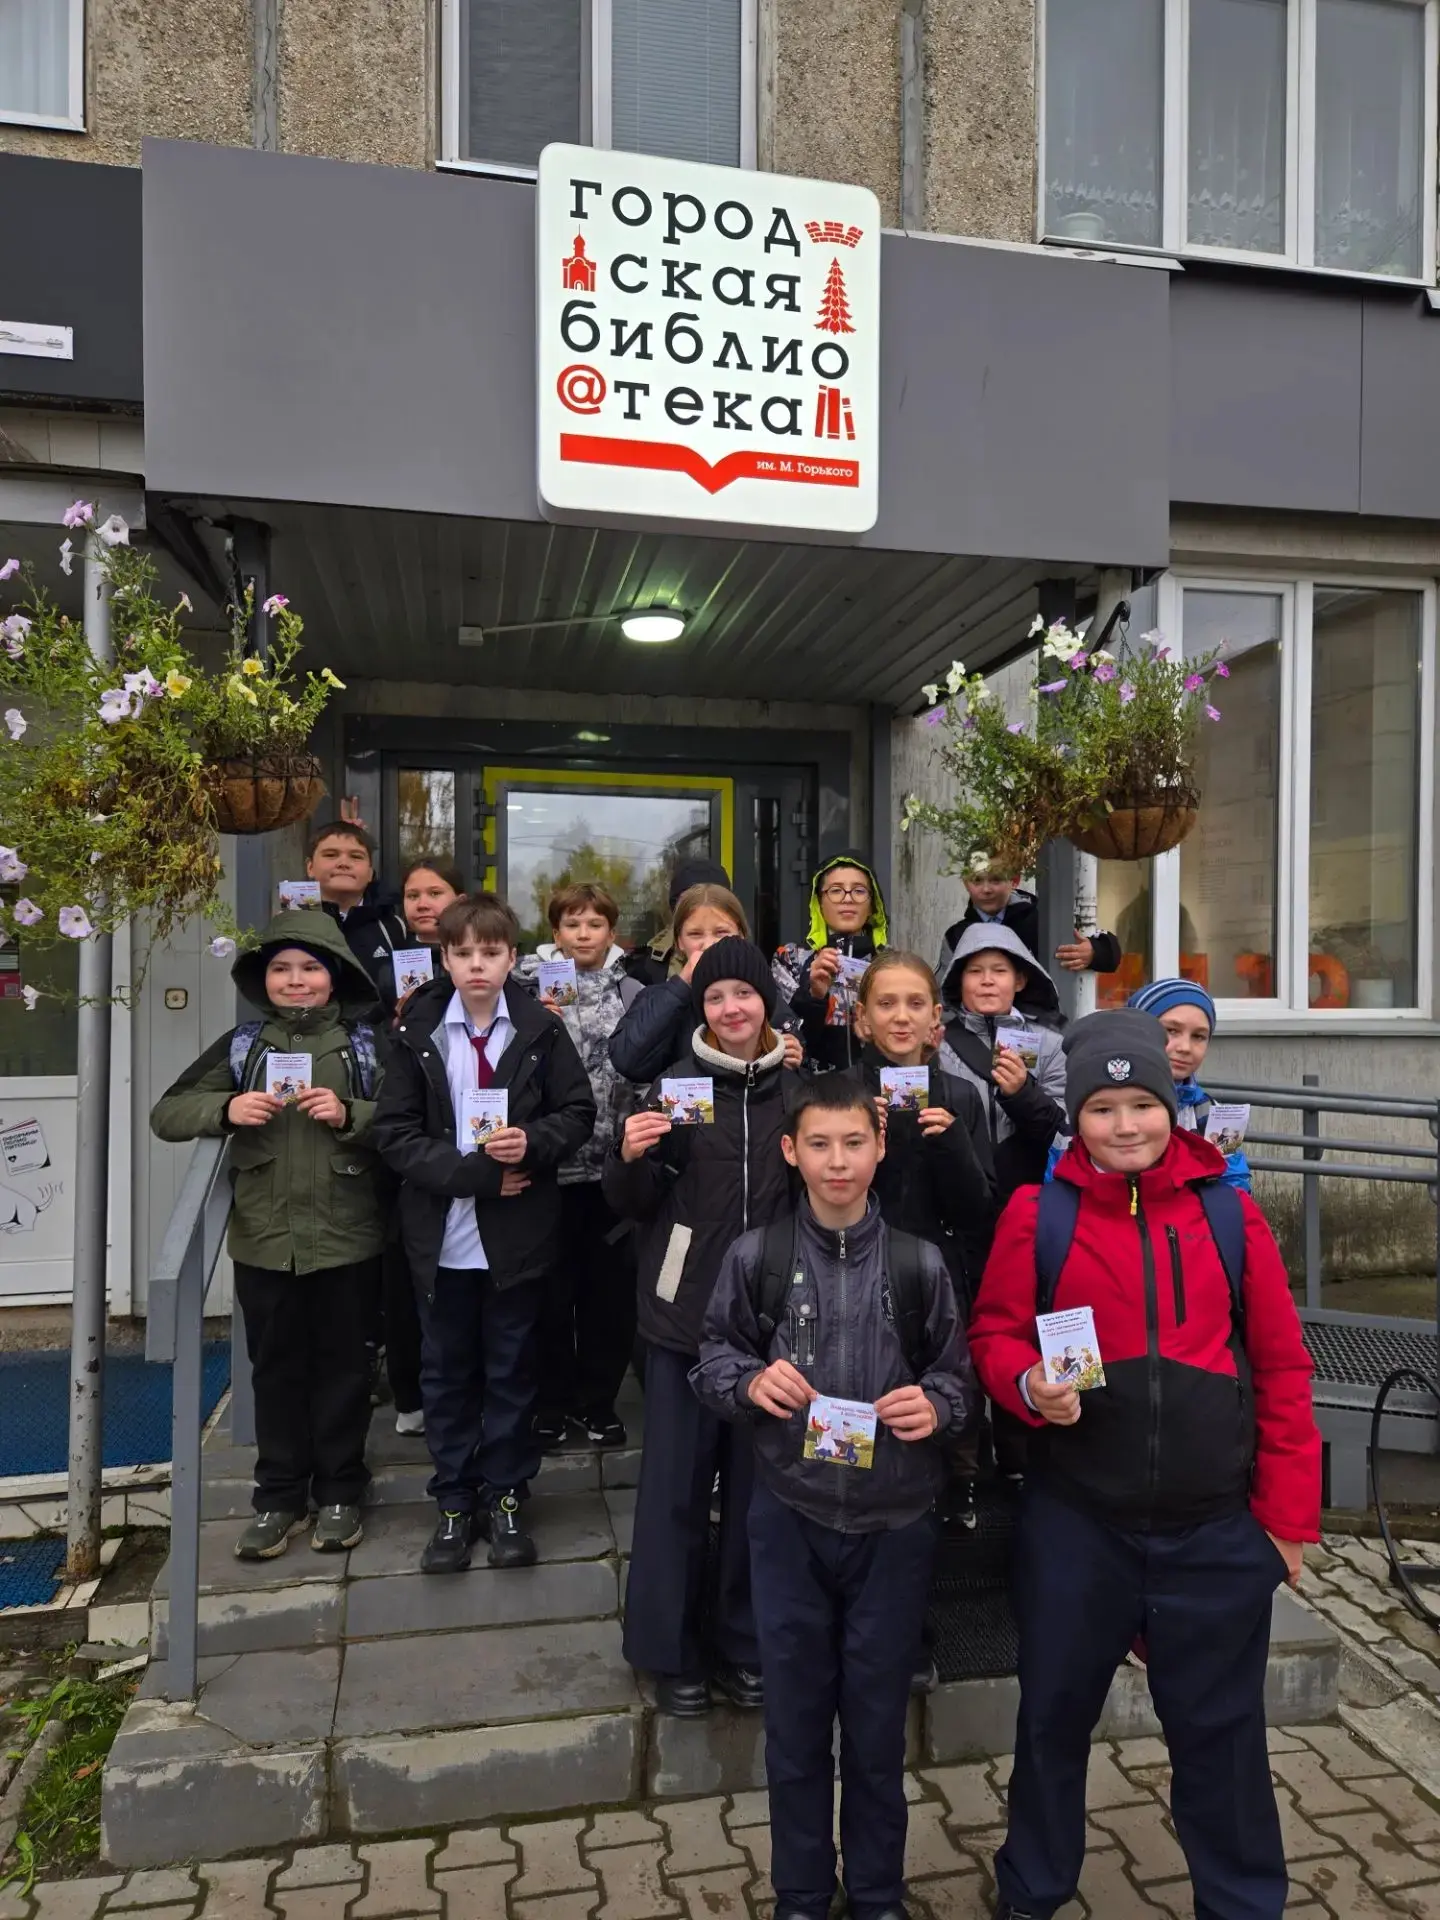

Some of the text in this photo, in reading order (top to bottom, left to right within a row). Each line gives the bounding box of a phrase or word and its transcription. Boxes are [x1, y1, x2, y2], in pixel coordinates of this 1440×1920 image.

[569, 178, 801, 258] город
[609, 253, 802, 313] ская
[559, 299, 850, 380] библио
[556, 364, 803, 436] @тека
[756, 461, 853, 477] им. М. Горького
